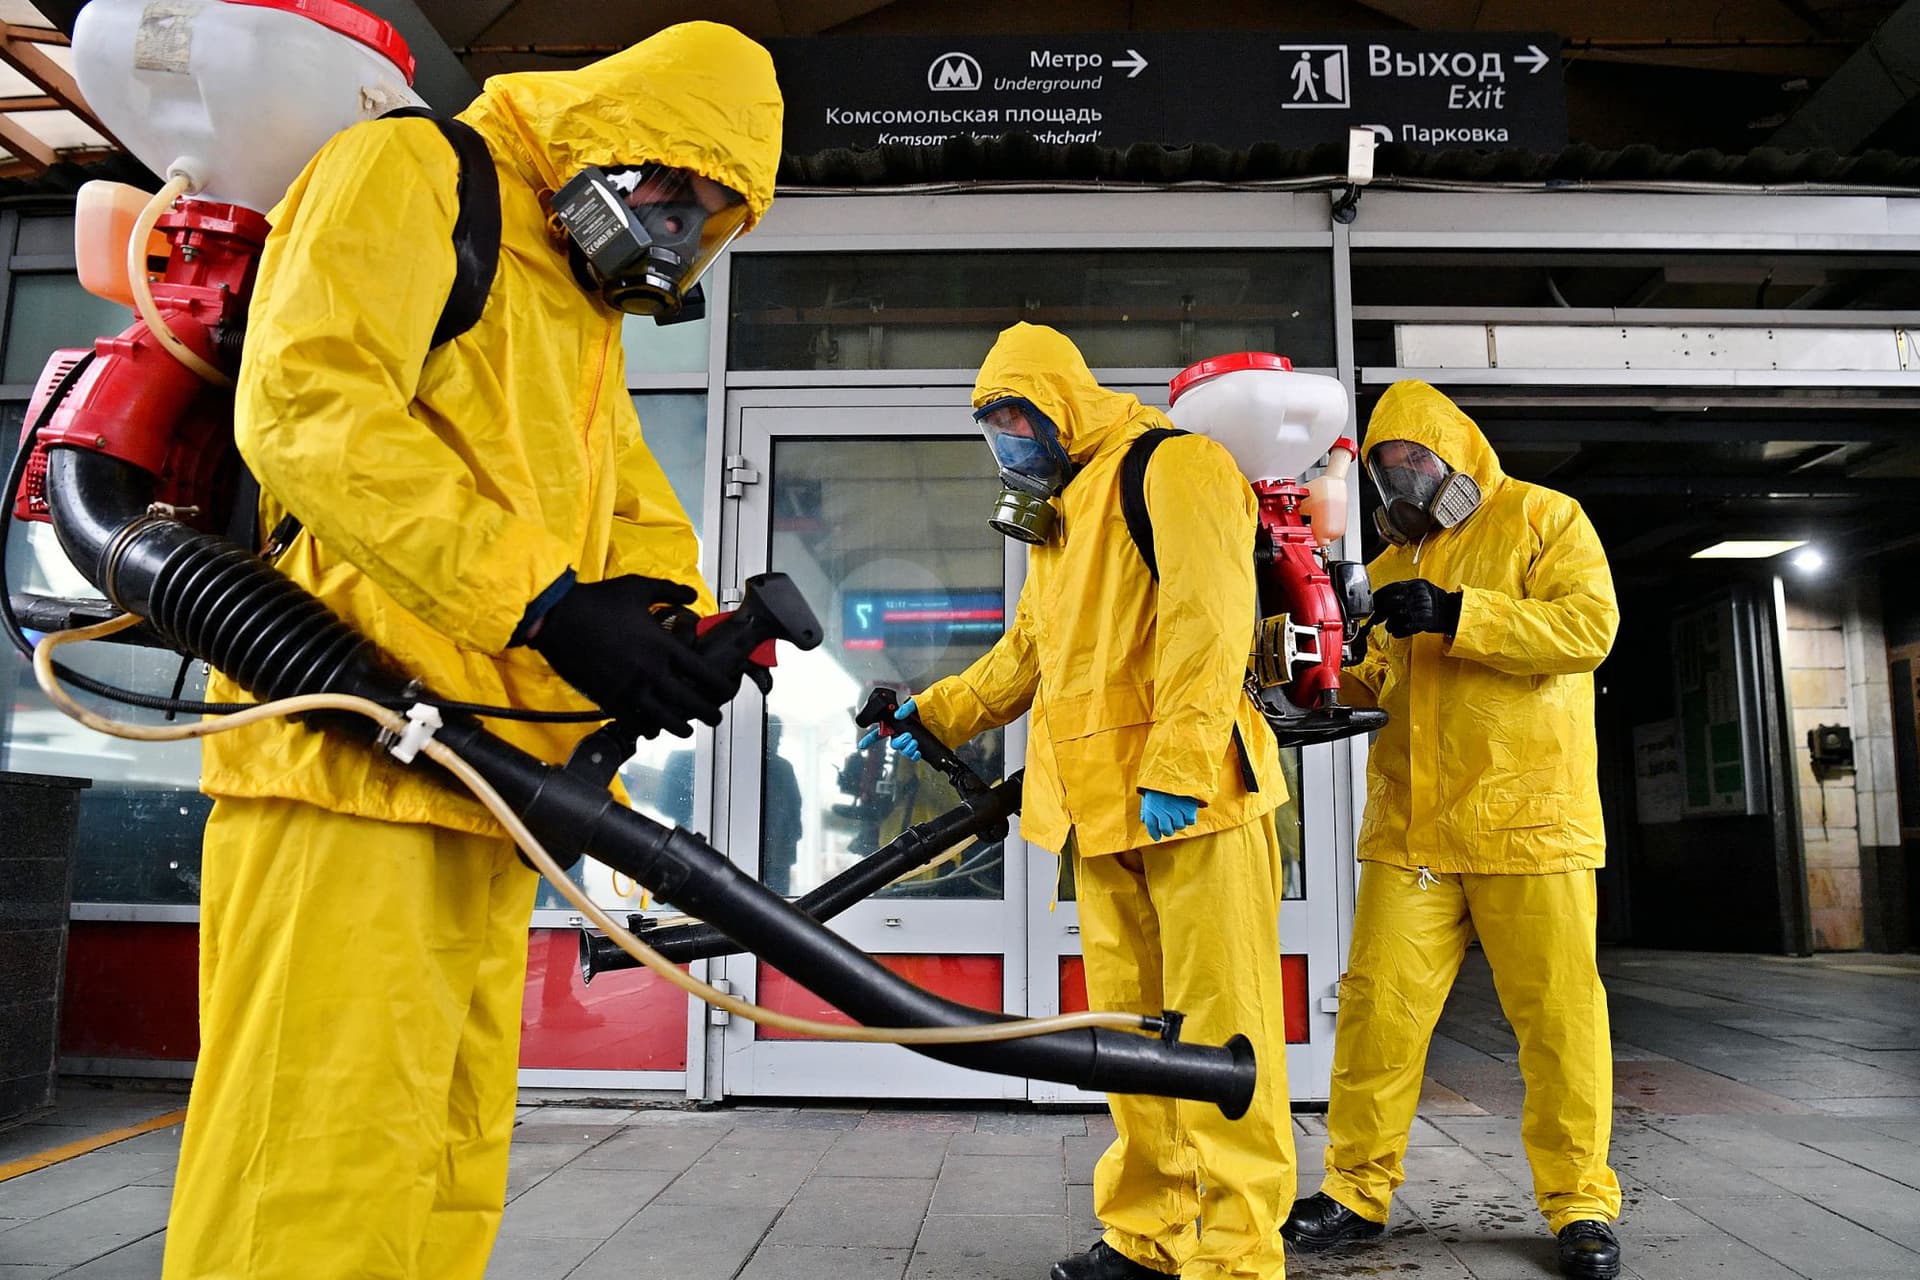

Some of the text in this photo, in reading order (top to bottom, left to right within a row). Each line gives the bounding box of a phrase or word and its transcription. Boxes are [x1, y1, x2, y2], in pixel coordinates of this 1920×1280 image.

[1031, 51, 1102, 71] Метро
[1369, 45, 1504, 82] Выход
[994, 76, 1102, 93] Underground
[1449, 85, 1505, 108] Exit
[827, 108, 1102, 124] Комсомольская площадь
[1403, 125, 1508, 145] Парковка
